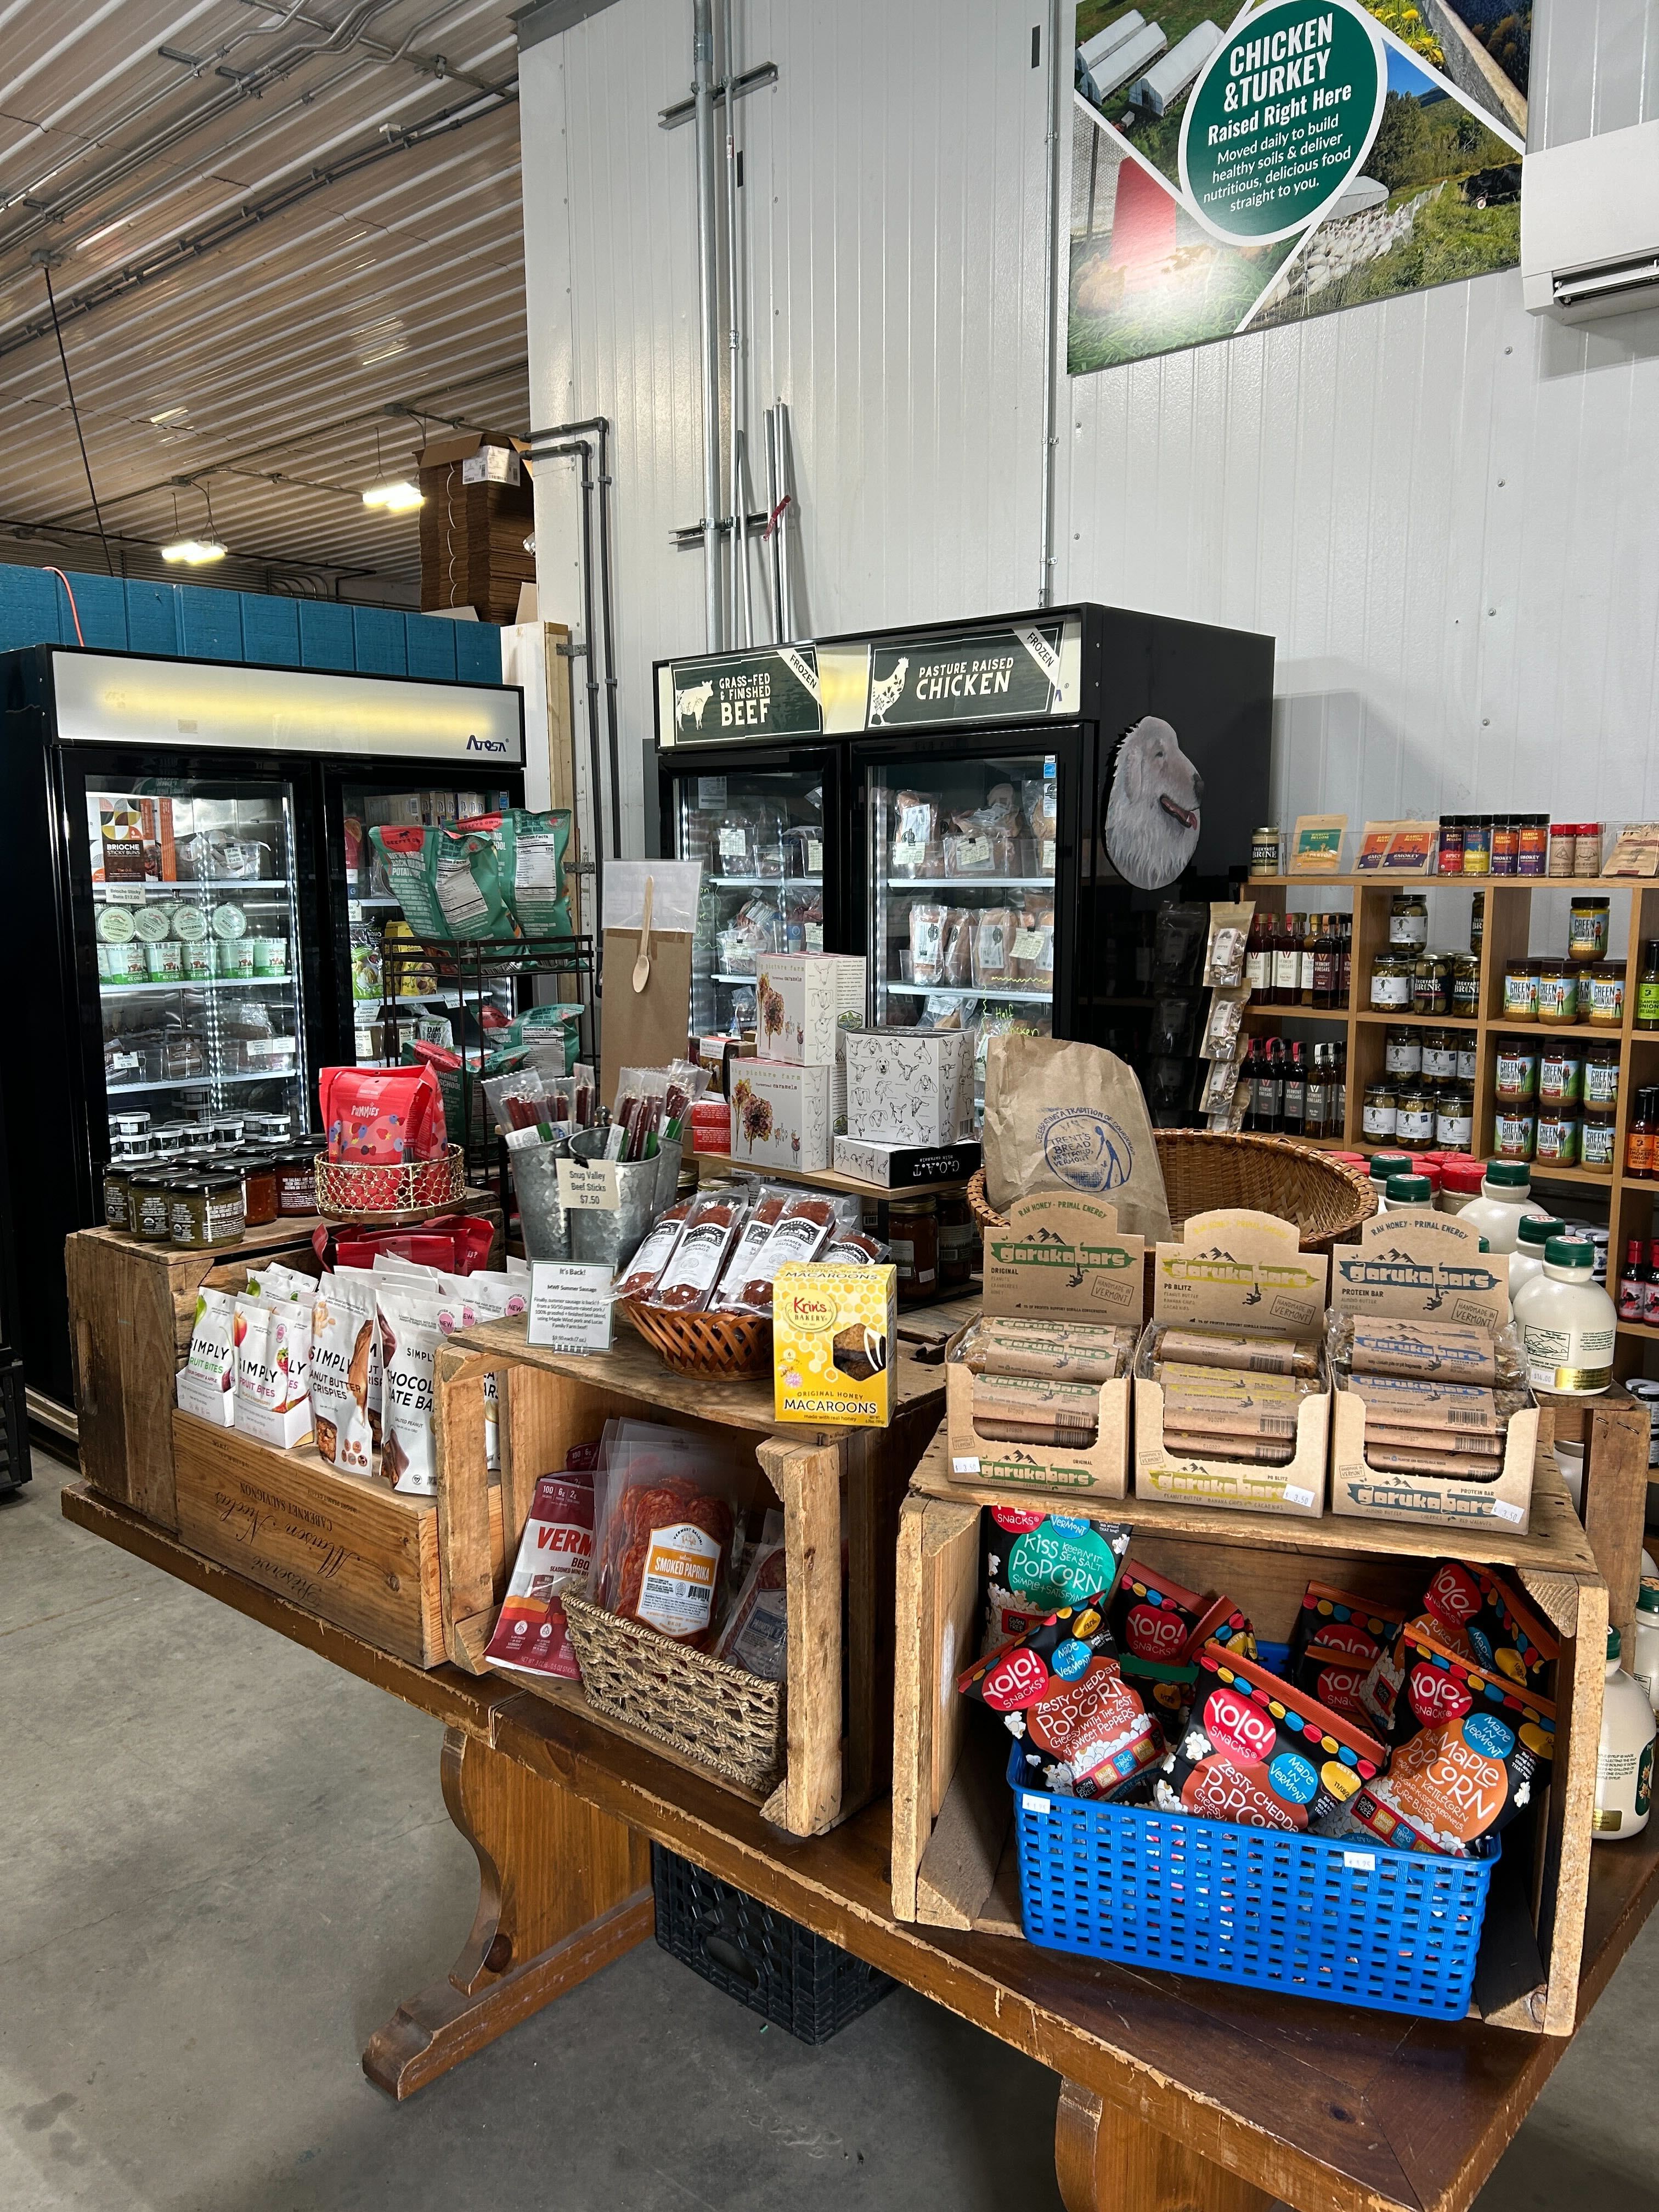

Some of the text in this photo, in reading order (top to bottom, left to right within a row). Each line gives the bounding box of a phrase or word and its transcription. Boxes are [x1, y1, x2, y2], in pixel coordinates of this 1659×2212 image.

[1230, 13, 1333, 76] CHICKEN
[1208, 84, 1351, 146] Raised Right Here
[1217, 114, 1339, 165] Moved daily to build
[1212, 134, 1343, 183] healthy soils & deliver
[1204, 145, 1351, 203] nutritious, delicious food
[1230, 177, 1319, 211] straight to you.
[1026, 631, 1054, 668] FROZEN
[789, 654, 817, 689] FROZEN
[919, 657, 1014, 678] PASTURE RAISED
[719, 673, 770, 689] GRASS-FED
[916, 670, 1011, 701] CHICKEN
[720, 686, 771, 701] & FINISHED
[720, 698, 771, 726] BEEF
[1575, 919, 1595, 930] GREEN
[1510, 982, 1530, 992] GREEN
[996, 1004, 1014, 1020] Half
[782, 1070, 801, 1080] farm
[1066, 1108, 1103, 1118] TRADITION
[1048, 1133, 1091, 1146] TRENT'S
[1054, 1141, 1091, 1154] BREAD
[1053, 1155, 1089, 1167] VERMONT
[569, 1171, 605, 1181] Snug Valley
[587, 1183, 606, 1192] Sticks
[580, 1195, 600, 1205] $7.50
[1018, 1201, 1107, 1219] RAW HONEY PRIMAL ENERGY
[1097, 1280, 1124, 1293] HANDMADE
[1095, 1288, 1128, 1303] VERMONT
[794, 1297, 827, 1313] Krin's
[1277, 1299, 1306, 1311] HANDMADE
[1274, 1306, 1309, 1322] VERMONT
[1456, 1311, 1493, 1327] VERMONT
[190, 1357, 223, 1374] RUIT BITES
[309, 1370, 361, 1393] ANUT BUTTER
[1534, 1373, 1551, 1383] $14.00
[240, 1376, 274, 1397] FRUIT BITES
[313, 1383, 347, 1400] CRISPIES
[785, 1399, 876, 1414] MACAROONS
[240, 1482, 285, 1510] SAUVIGNON
[543, 1485, 577, 1499] 100 6g 2g
[1294, 1494, 1308, 1505] 3.50
[215, 1492, 275, 1544] Nicolas
[288, 1502, 332, 1531] CABERNET
[1502, 1510, 1517, 1521] 3.50
[537, 1526, 592, 1558] VERM
[285, 1523, 360, 1578] Maison
[572, 1558, 590, 1570] BBQ
[655, 1557, 709, 1581] SMOKED PAPRIKA
[1060, 1551, 1102, 1571] SEA SALT
[1433, 1568, 1477, 1618] YOLO!
[1128, 1613, 1184, 1646] YOLO!
[1066, 1655, 1074, 1664] IN
[984, 1650, 1040, 1699] YOLO!
[1483, 1727, 1496, 1739] IN
[1336, 1762, 1347, 1774] BEST
[1079, 1786, 1097, 1798] FREE
